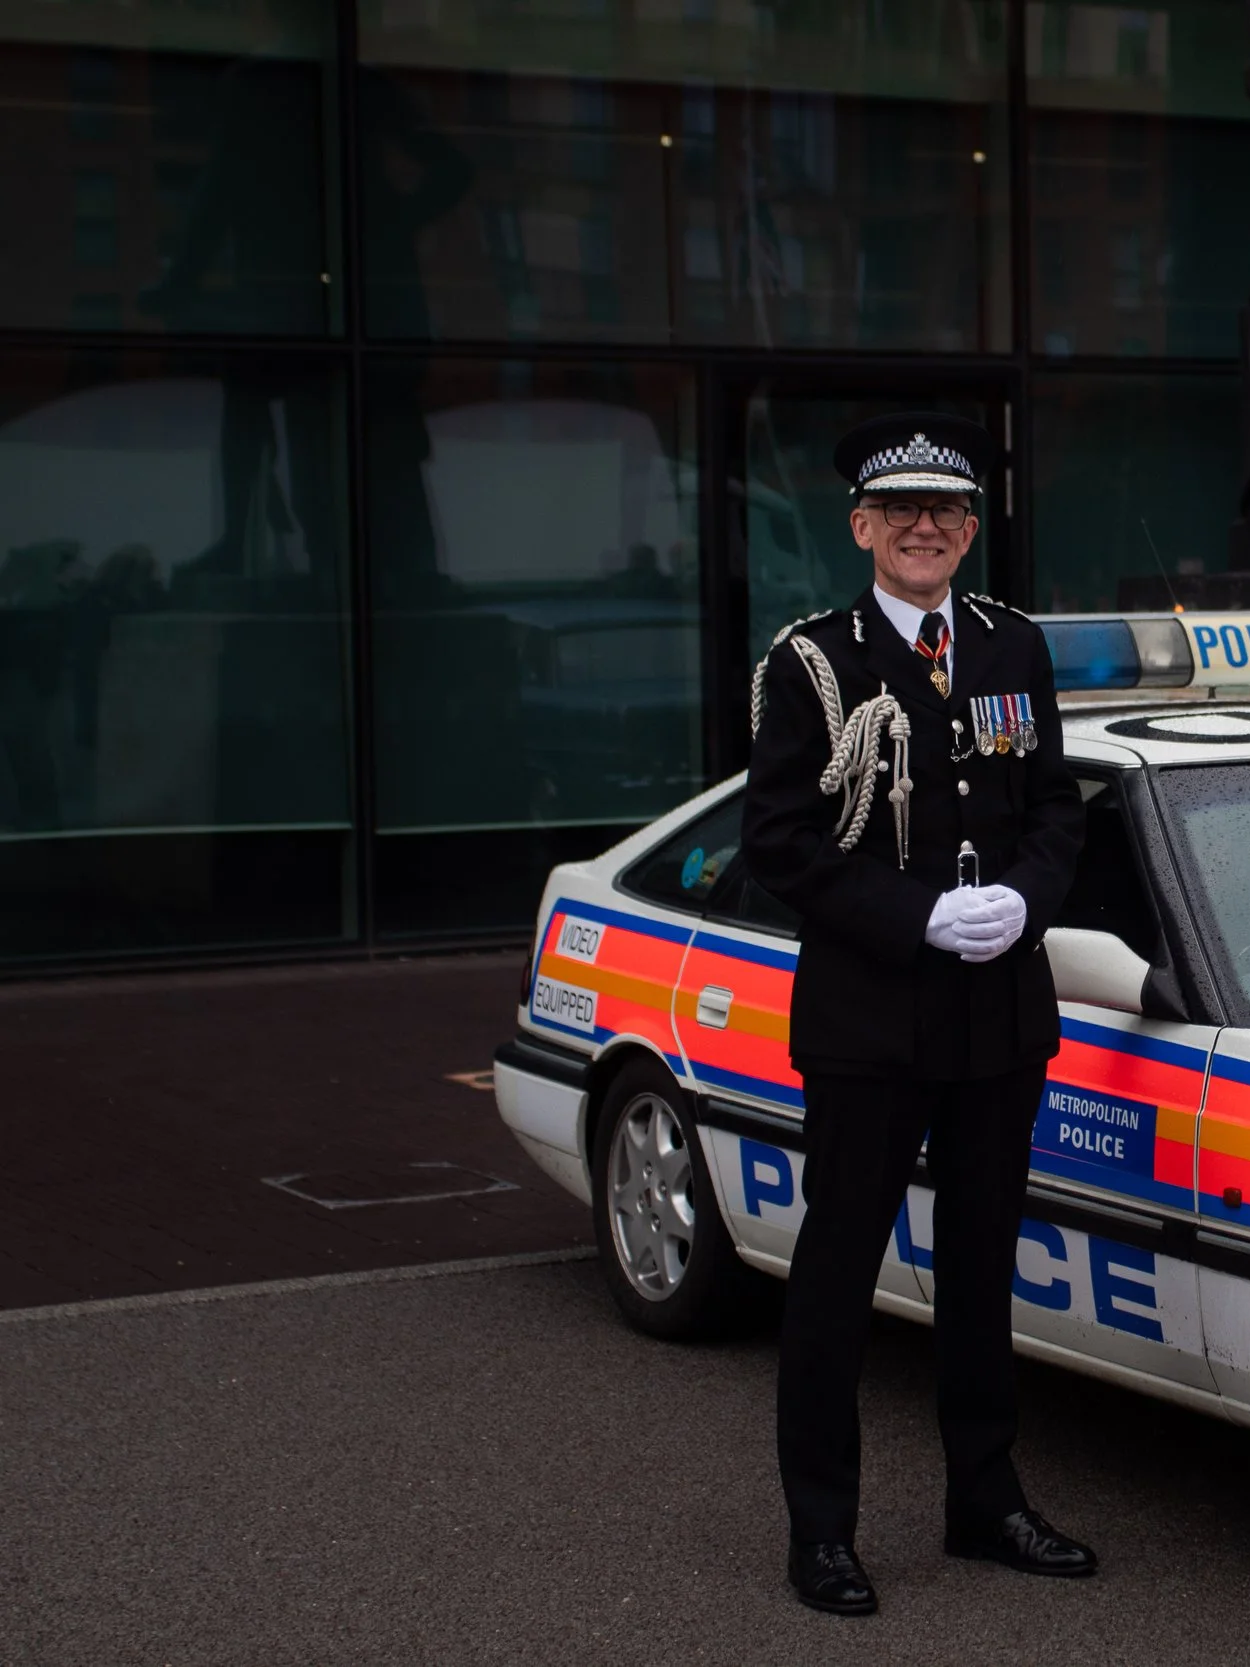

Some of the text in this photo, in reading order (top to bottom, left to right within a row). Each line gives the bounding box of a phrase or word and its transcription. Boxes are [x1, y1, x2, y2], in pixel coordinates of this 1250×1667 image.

[560, 923, 599, 955] VIDEO
[536, 982, 593, 1023] EQUIPPED
[1048, 1091, 1140, 1131] METROPOLITAN
[1059, 1123, 1125, 1160] POLICE
[739, 1136, 1165, 1344] PLCE
